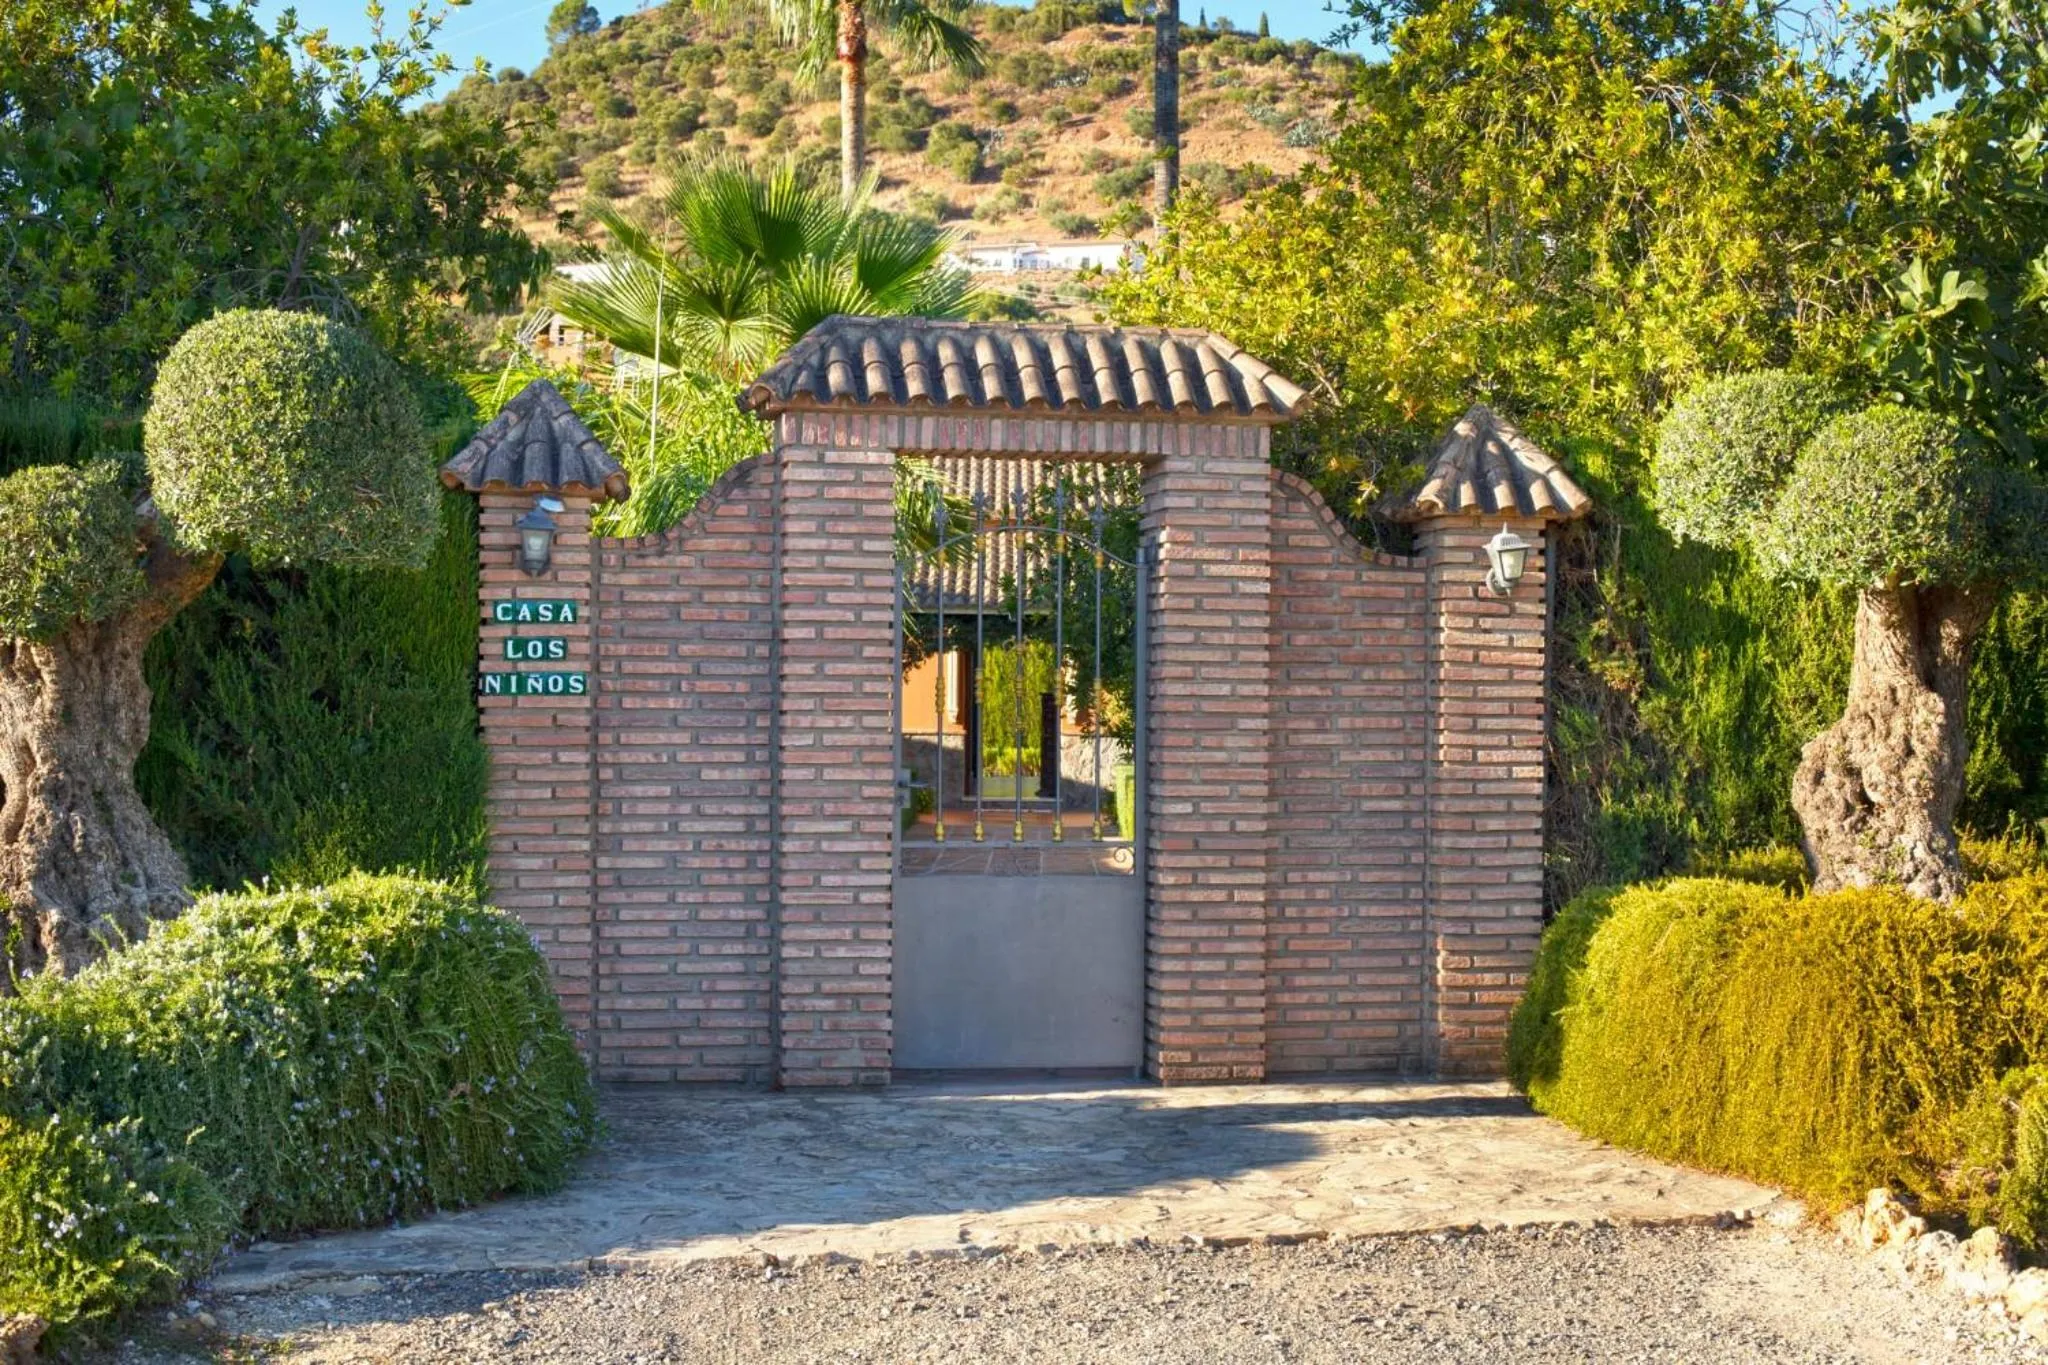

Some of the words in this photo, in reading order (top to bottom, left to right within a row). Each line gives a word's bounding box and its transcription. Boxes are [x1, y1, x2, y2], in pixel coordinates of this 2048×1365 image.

[496, 603, 573, 622] CASA
[507, 640, 564, 658] LOS
[485, 673, 584, 693] NIÑOS
